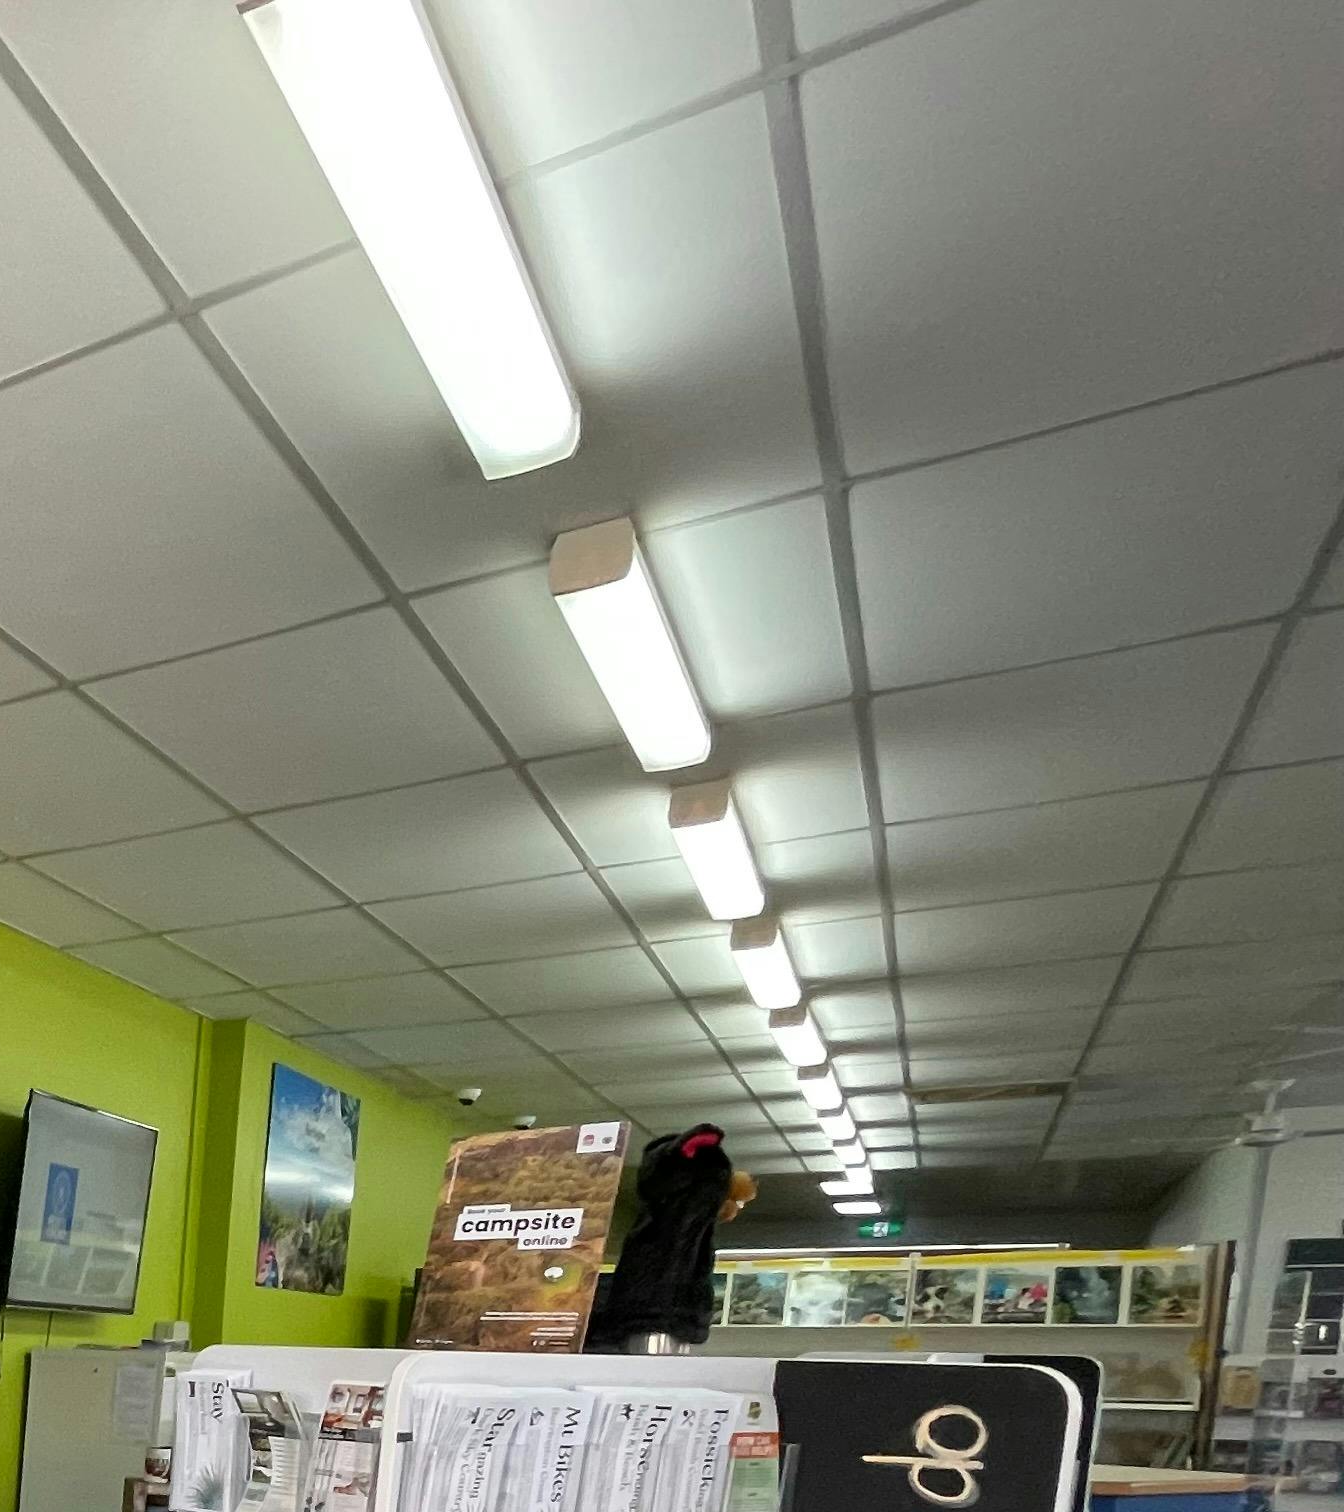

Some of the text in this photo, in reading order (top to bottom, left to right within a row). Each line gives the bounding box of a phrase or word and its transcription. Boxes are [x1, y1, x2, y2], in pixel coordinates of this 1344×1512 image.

[462, 1213, 575, 1237] campsite
[523, 1235, 568, 1246] online
[551, 1444, 573, 1503] Bikes
[861, 1403, 989, 1507] do
